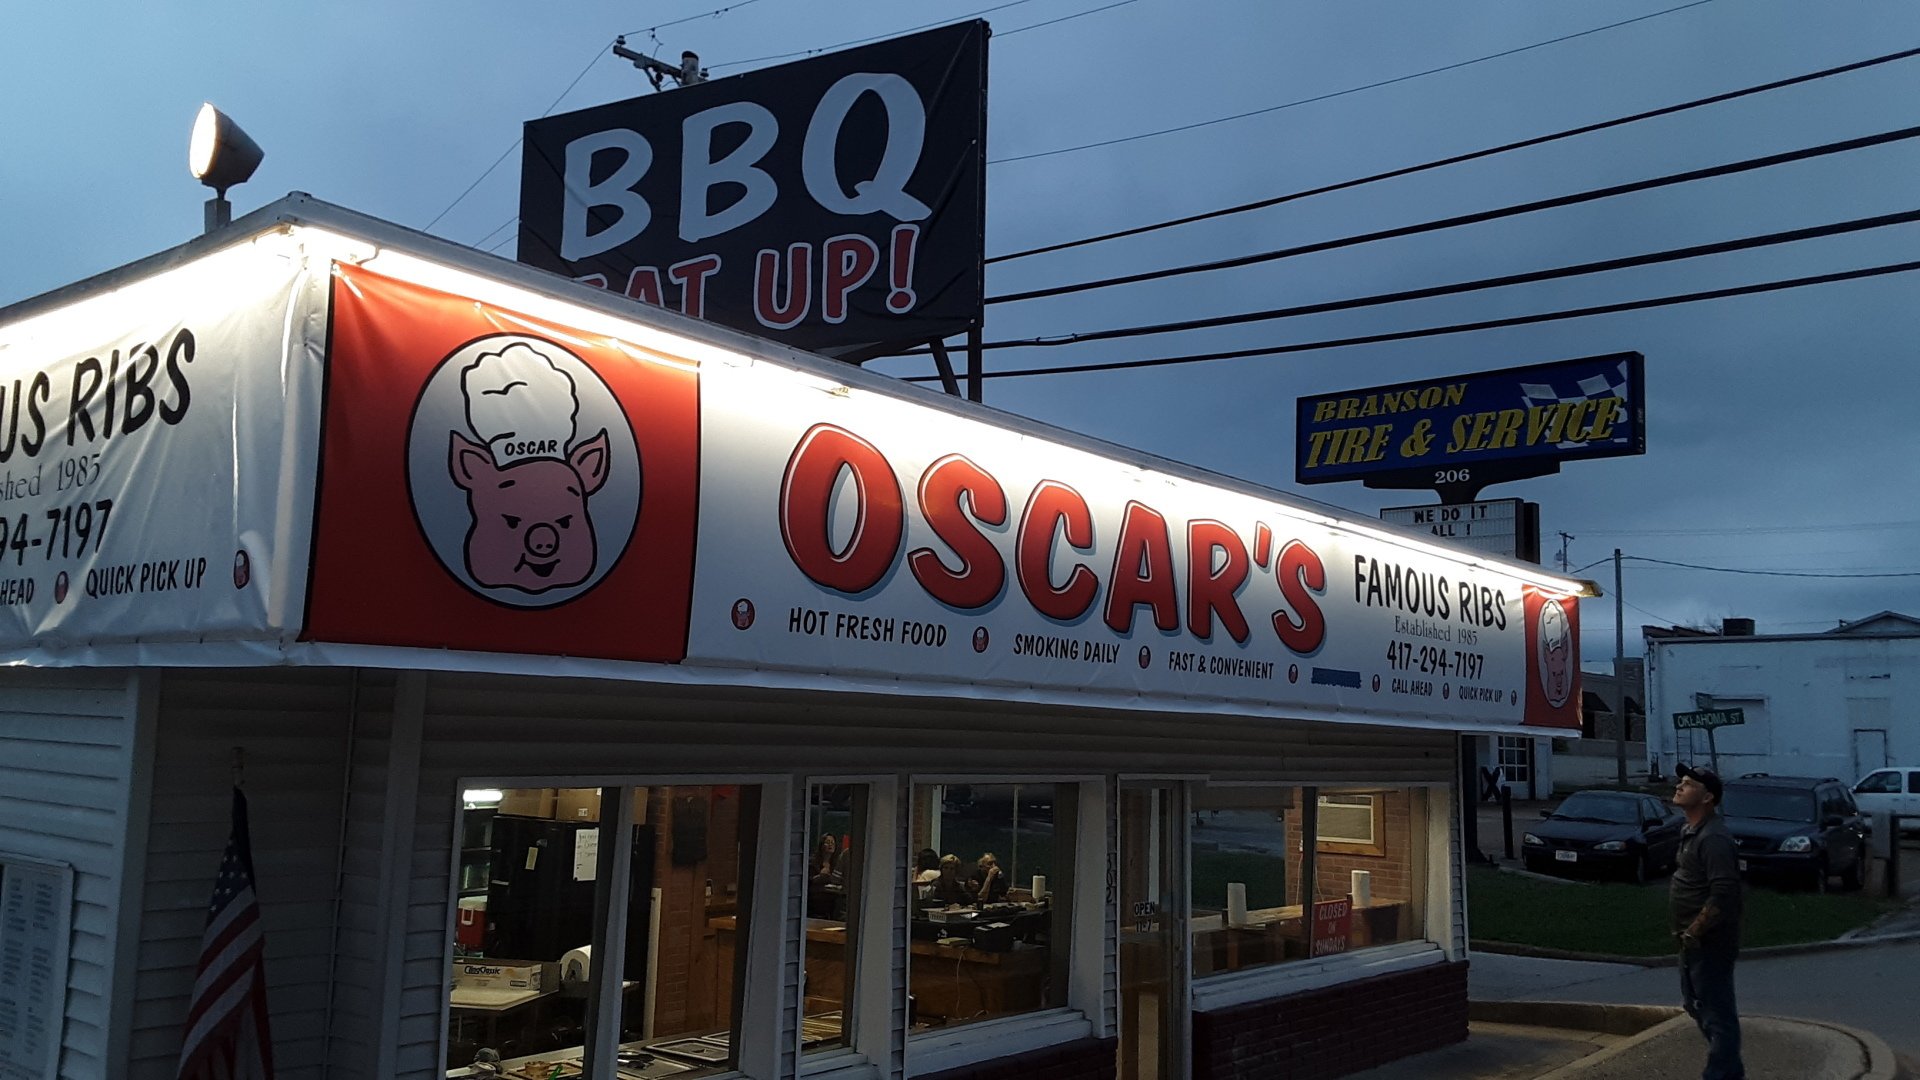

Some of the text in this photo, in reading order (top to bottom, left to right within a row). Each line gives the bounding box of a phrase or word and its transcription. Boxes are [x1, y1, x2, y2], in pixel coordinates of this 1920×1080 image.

[560, 72, 932, 262] BBQ
[574, 224, 920, 329] AT UP!
[67, 327, 195, 446] RIBS
[1313, 383, 1468, 422] BRANSON
[504, 439, 558, 457] OSCAR
[1304, 397, 1627, 468] TIRE & SERVICE
[57, 453, 101, 492] 1985
[1434, 469, 1470, 484] 206
[1414, 505, 1488, 524] WE DO IT
[779, 422, 1327, 654] OSCAR'S
[1432, 525, 1456, 538] ALL
[86, 556, 206, 599] QUICK PICK UP
[1354, 554, 1507, 631] FAMOUS RIBS
[788, 607, 947, 647] HOT FRESH FOOD
[1394, 615, 1478, 646] Established 1985
[1013, 633, 1120, 665] SMOKING DAILY
[1387, 640, 1484, 680] 417-294-7197
[1168, 650, 1274, 681] FAST & CONVENIENT
[1391, 678, 1433, 697] CALL AHEAD
[1459, 685, 1503, 704] QUICK PICK UP
[1677, 712, 1740, 728] OKLAHOMA ST
[1134, 902, 1155, 915] OPEN
[1319, 902, 1348, 921] CLOSED
[1315, 935, 1346, 955] SUNDAYS
